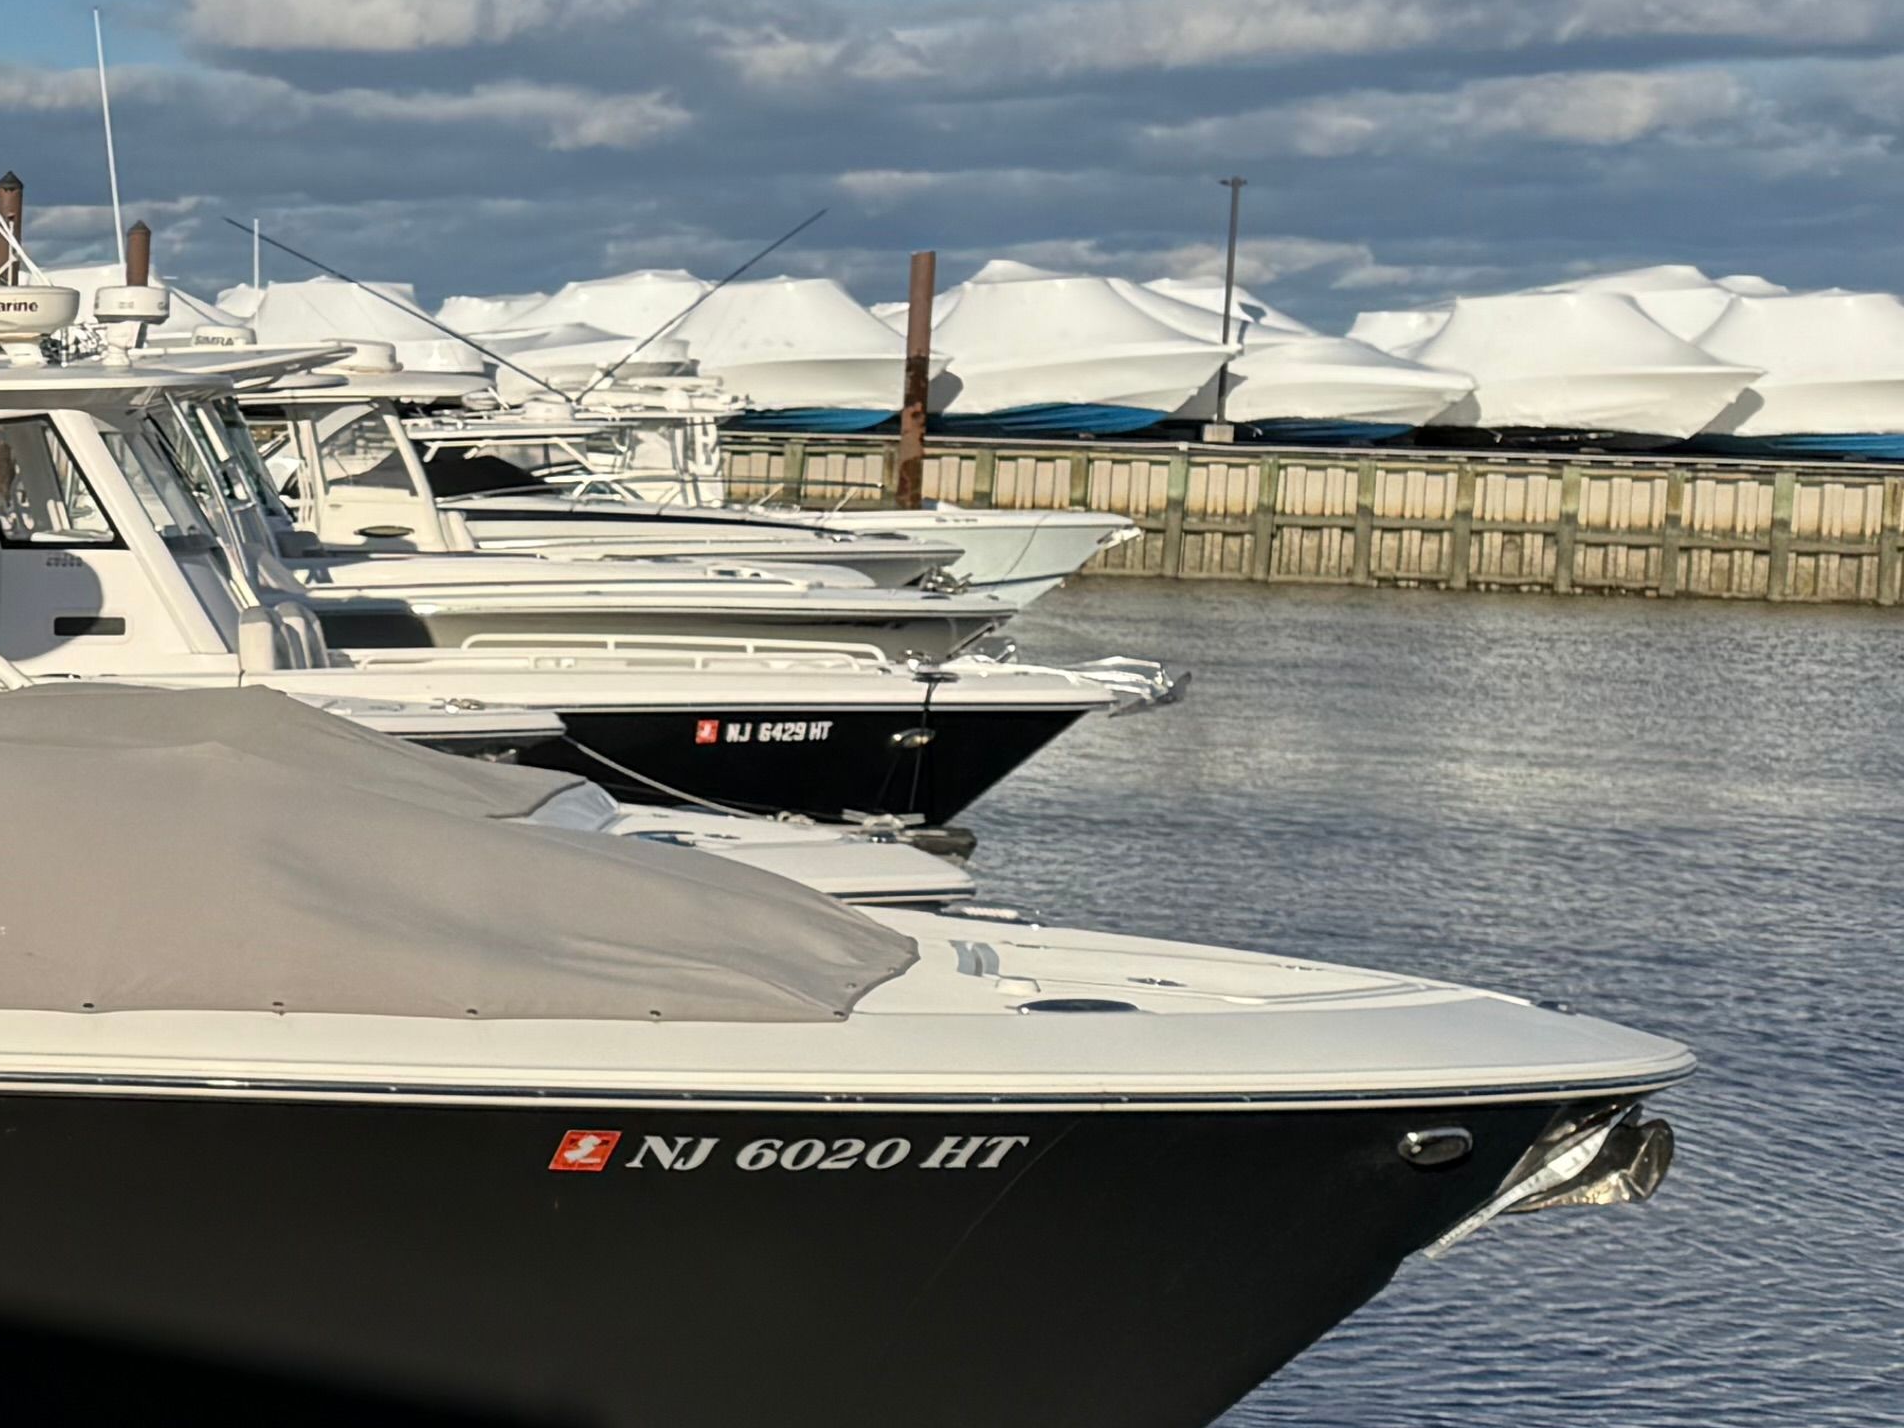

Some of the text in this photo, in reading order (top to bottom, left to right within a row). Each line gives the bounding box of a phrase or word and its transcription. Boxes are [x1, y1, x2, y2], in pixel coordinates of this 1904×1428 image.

[725, 721, 833, 743] NJ 6429 HT
[625, 1135, 1030, 1171] NJ 6020 HT
